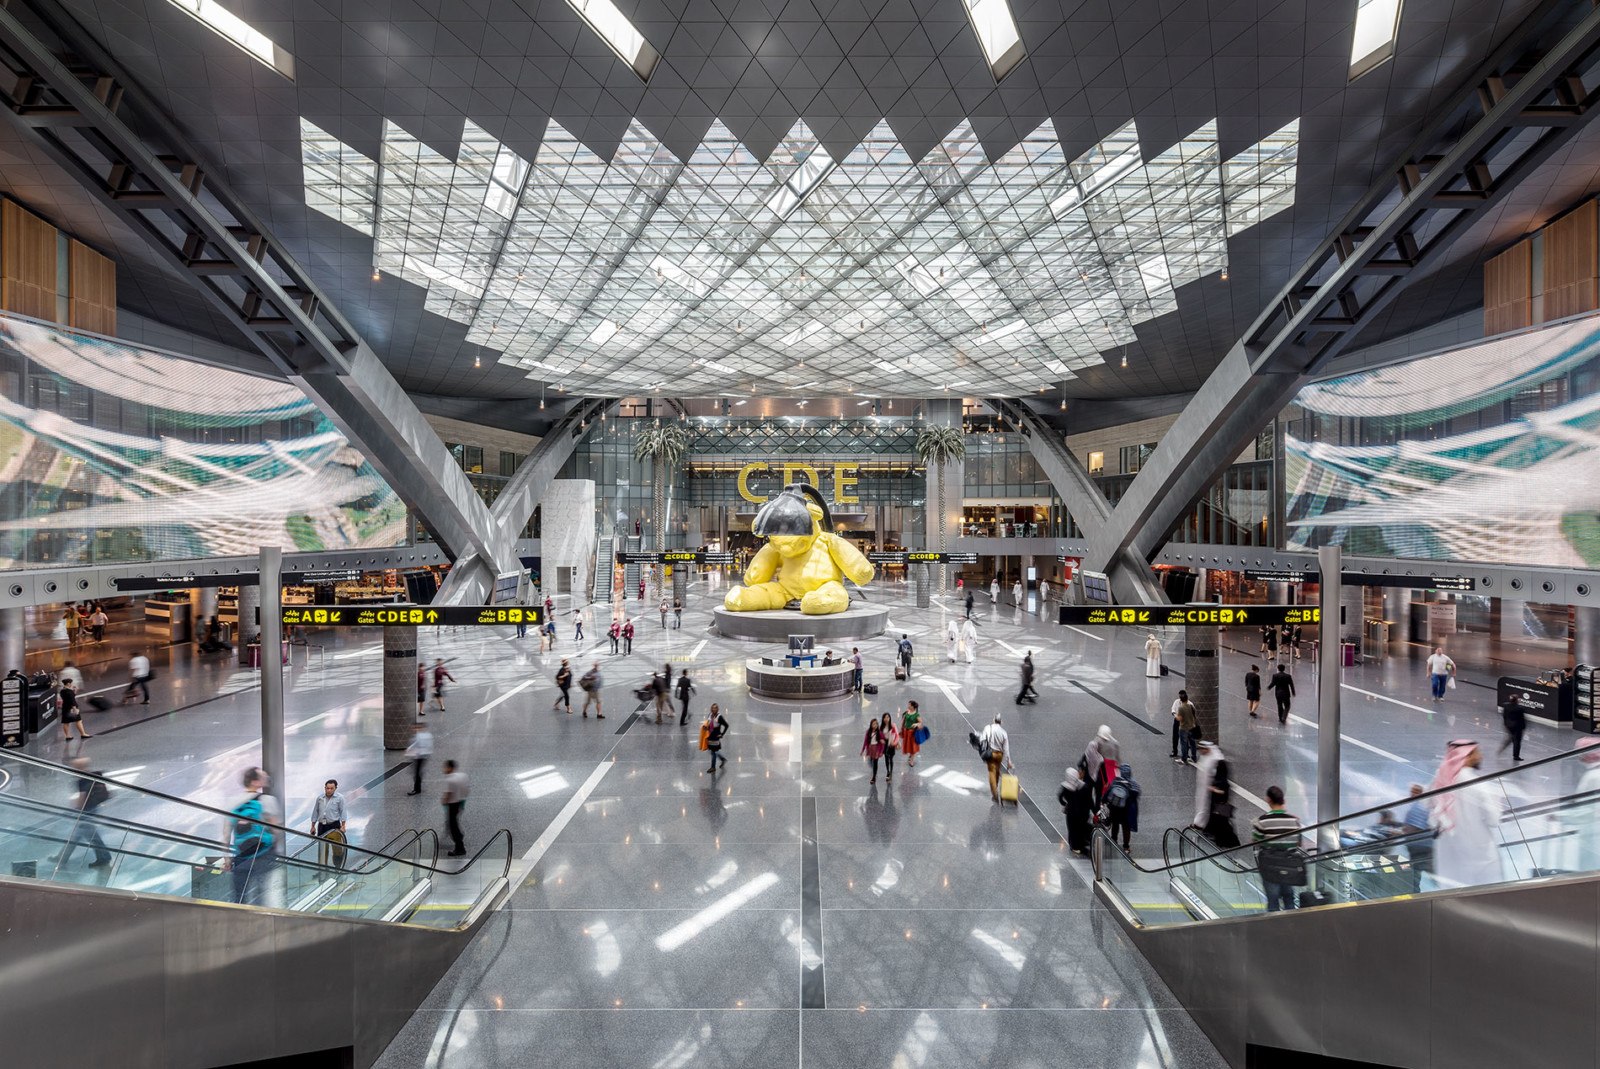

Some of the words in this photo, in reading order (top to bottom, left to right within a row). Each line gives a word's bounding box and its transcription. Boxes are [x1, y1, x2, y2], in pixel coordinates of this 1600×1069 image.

[302, 611, 313, 622] A
[498, 611, 507, 621] B
[1108, 611, 1119, 622] A
[1303, 610, 1312, 621] B
